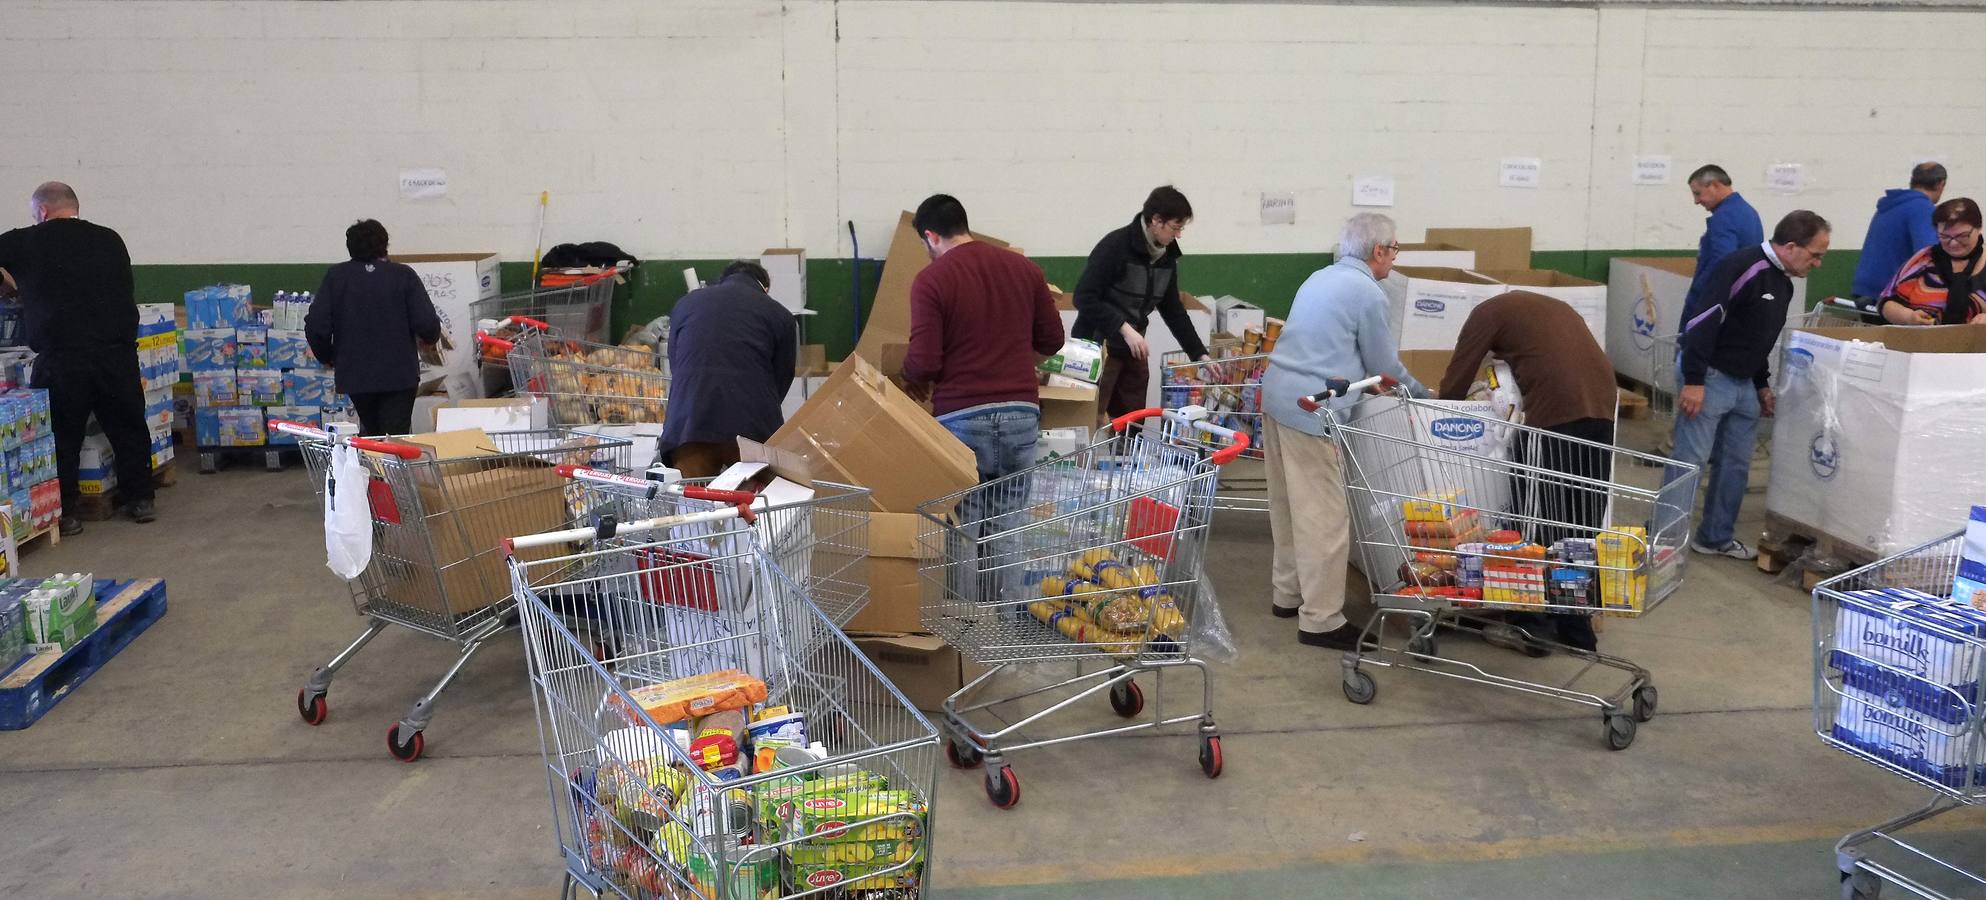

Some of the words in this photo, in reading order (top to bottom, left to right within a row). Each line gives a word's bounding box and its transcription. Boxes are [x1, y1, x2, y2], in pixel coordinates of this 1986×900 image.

[1434, 422, 1481, 433] DANONE
[1863, 621, 1931, 663] bomilk
[811, 872, 839, 883] Juver
